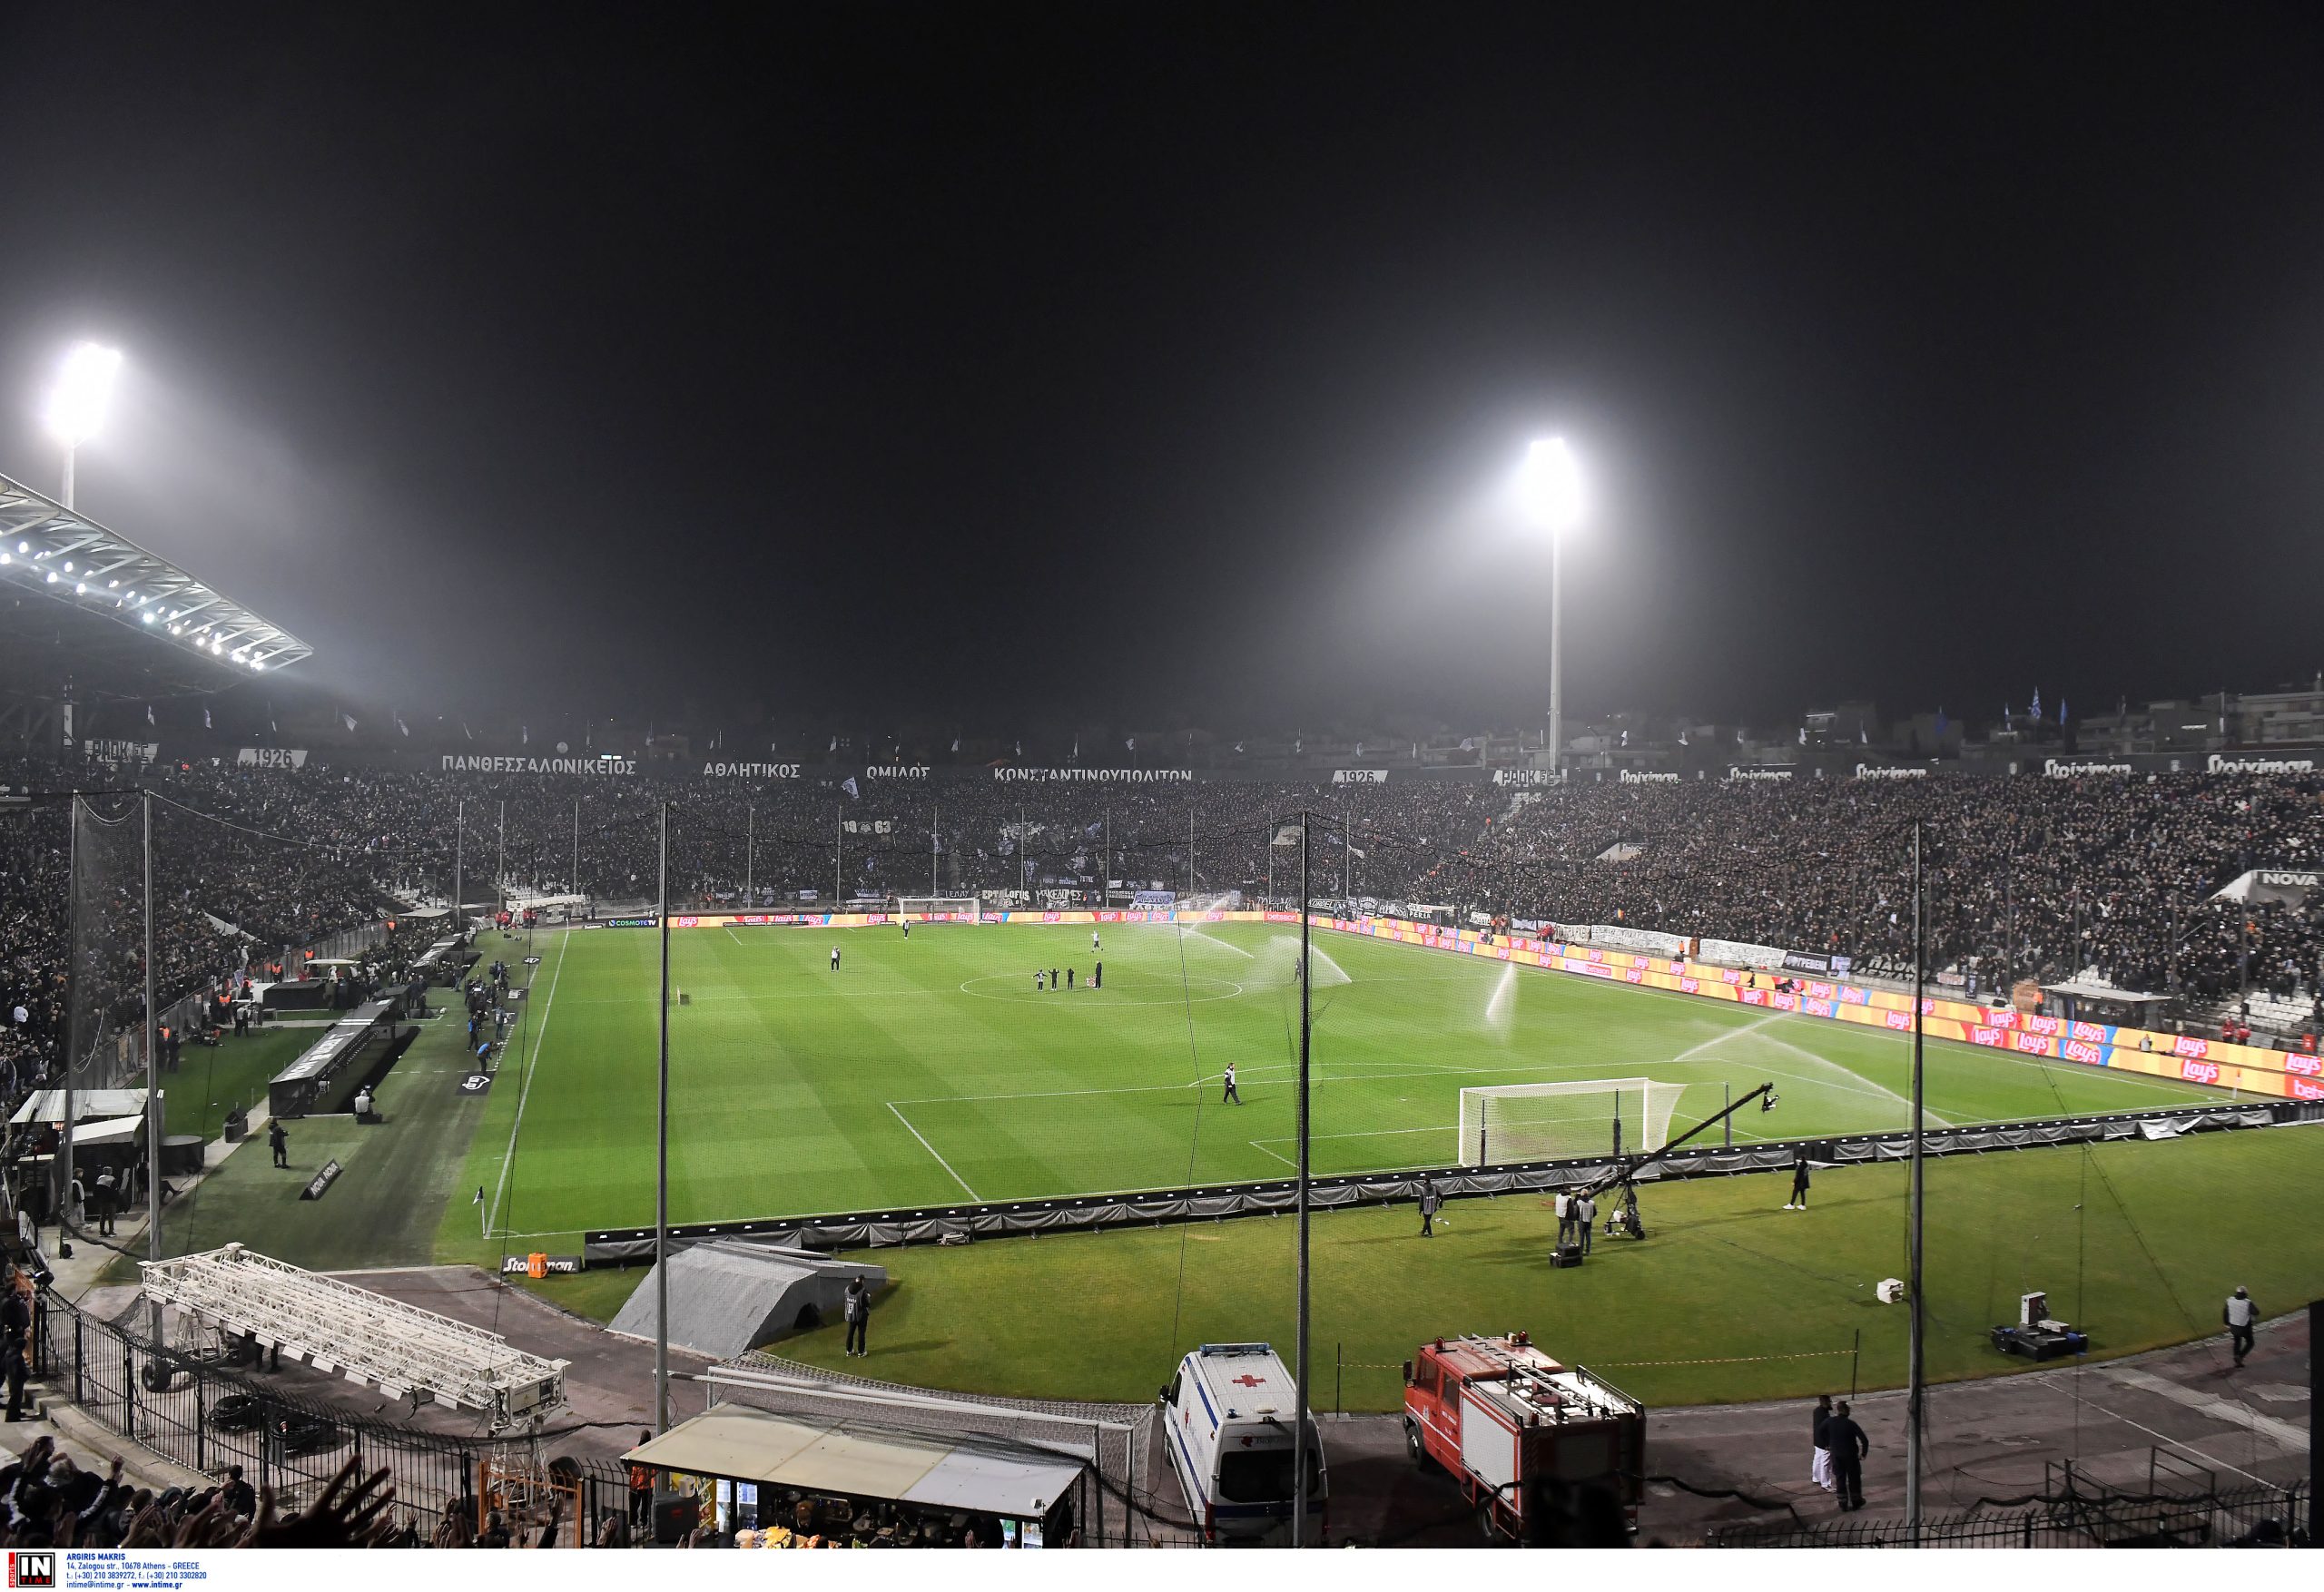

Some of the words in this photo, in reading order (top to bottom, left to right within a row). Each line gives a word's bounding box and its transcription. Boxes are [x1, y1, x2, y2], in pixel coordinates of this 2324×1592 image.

[253, 749, 292, 767] 1926
[442, 755, 636, 775] ΠΑΝΘΕΣΣΑΛΟΝΙΚΕΙΟΣ
[2207, 754, 2314, 775] Stoiximan
[703, 762, 801, 779] ΑΘΛΗΤΙΚΟΣ
[866, 765, 931, 779] ΟΜΙΛΟΣ
[1342, 771, 1374, 783] 1926
[1502, 770, 1536, 786] PAOK
[1620, 769, 1679, 783] Stoiximan
[1856, 763, 1927, 781] Stoiximan
[2043, 759, 2132, 779] Stoiximan
[842, 820, 858, 834] 19
[874, 820, 891, 834] 63
[2262, 872, 2319, 886] NOVA
[678, 917, 698, 927] Lay's
[1887, 1011, 1911, 1029] Lay's
[1989, 1011, 2014, 1027] Lay's
[2031, 1017, 2057, 1035] Lay's
[1975, 1029, 2001, 1046] Lay's
[2073, 1021, 2103, 1043] Lay's
[2019, 1033, 2048, 1053] Lay's
[2175, 1037, 2207, 1056] Lay's
[2066, 1041, 2099, 1064] Lay's
[2182, 1060, 2219, 1082] Lay's
[2286, 1053, 2321, 1075] Lay's
[310, 1176, 325, 1196] NOVA
[323, 1162, 340, 1181] NOVA
